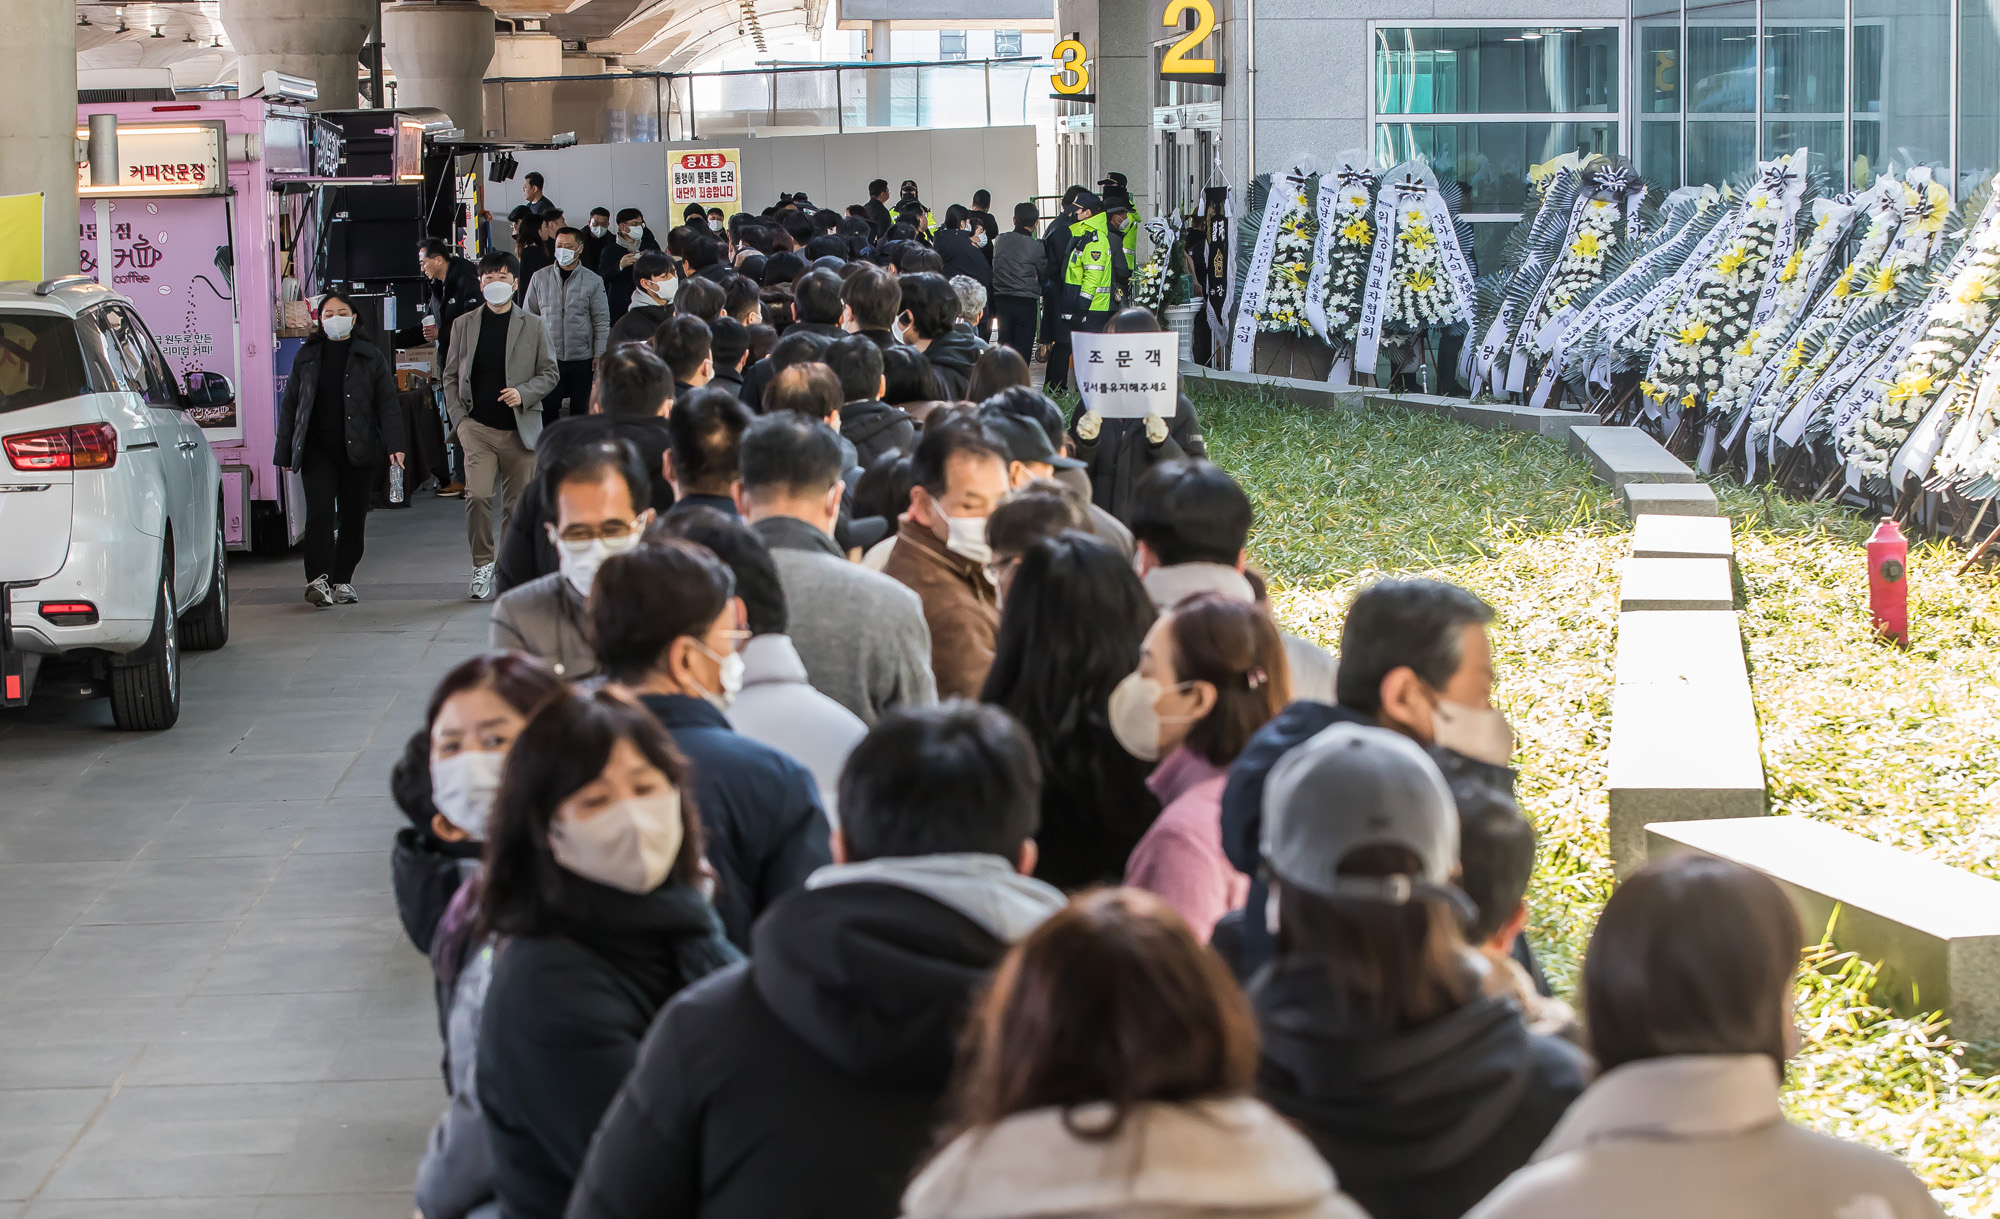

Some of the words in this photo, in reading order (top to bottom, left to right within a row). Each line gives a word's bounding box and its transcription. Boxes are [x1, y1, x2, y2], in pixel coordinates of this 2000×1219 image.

[1161, 0, 1215, 73] 2
[1051, 40, 1089, 94] 3
[687, 155, 720, 168] 공사중
[130, 163, 206, 182] 커피전문점
[721, 171, 734, 182] 드려
[676, 187, 697, 199] 대단히
[699, 186, 734, 198] 죄송합니다
[113, 271, 151, 285] coffee
[165, 334, 192, 345] 원두로
[194, 333, 212, 344] 만든
